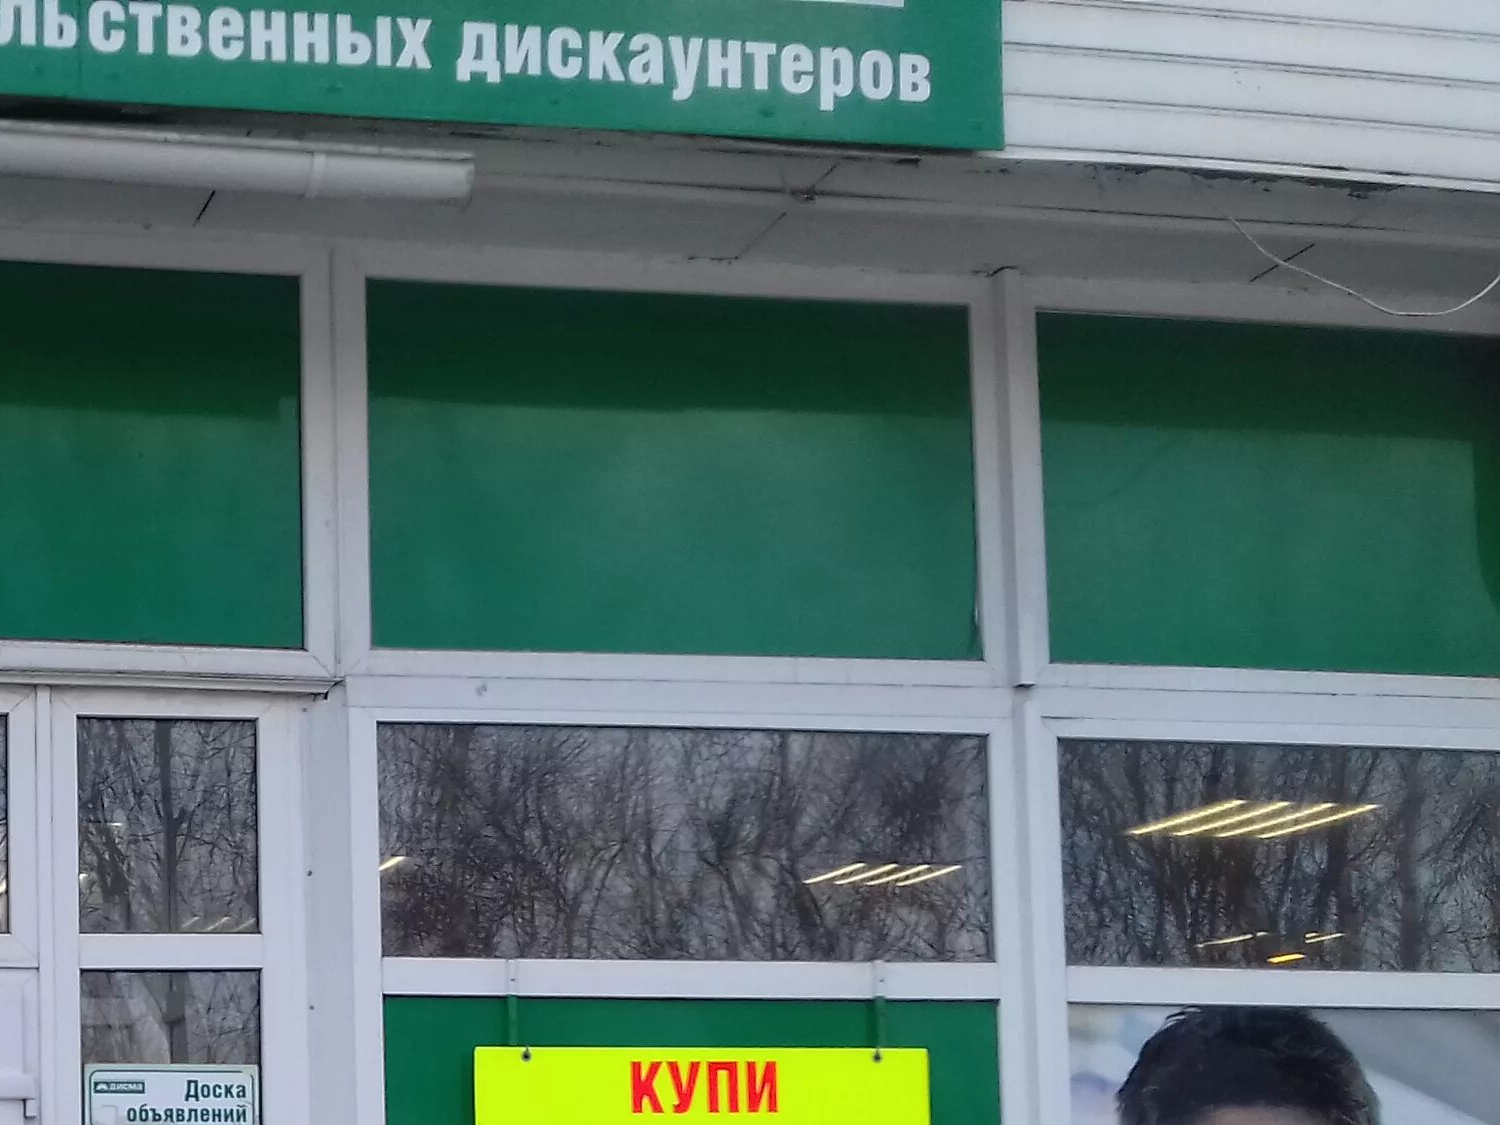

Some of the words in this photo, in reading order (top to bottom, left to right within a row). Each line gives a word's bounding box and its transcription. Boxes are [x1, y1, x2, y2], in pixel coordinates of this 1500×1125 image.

[456, 21, 932, 110] дискаунтеров
[185, 1079, 247, 1102] Доска
[630, 1060, 779, 1114] КУПИ
[126, 1103, 247, 1124] объявлений
